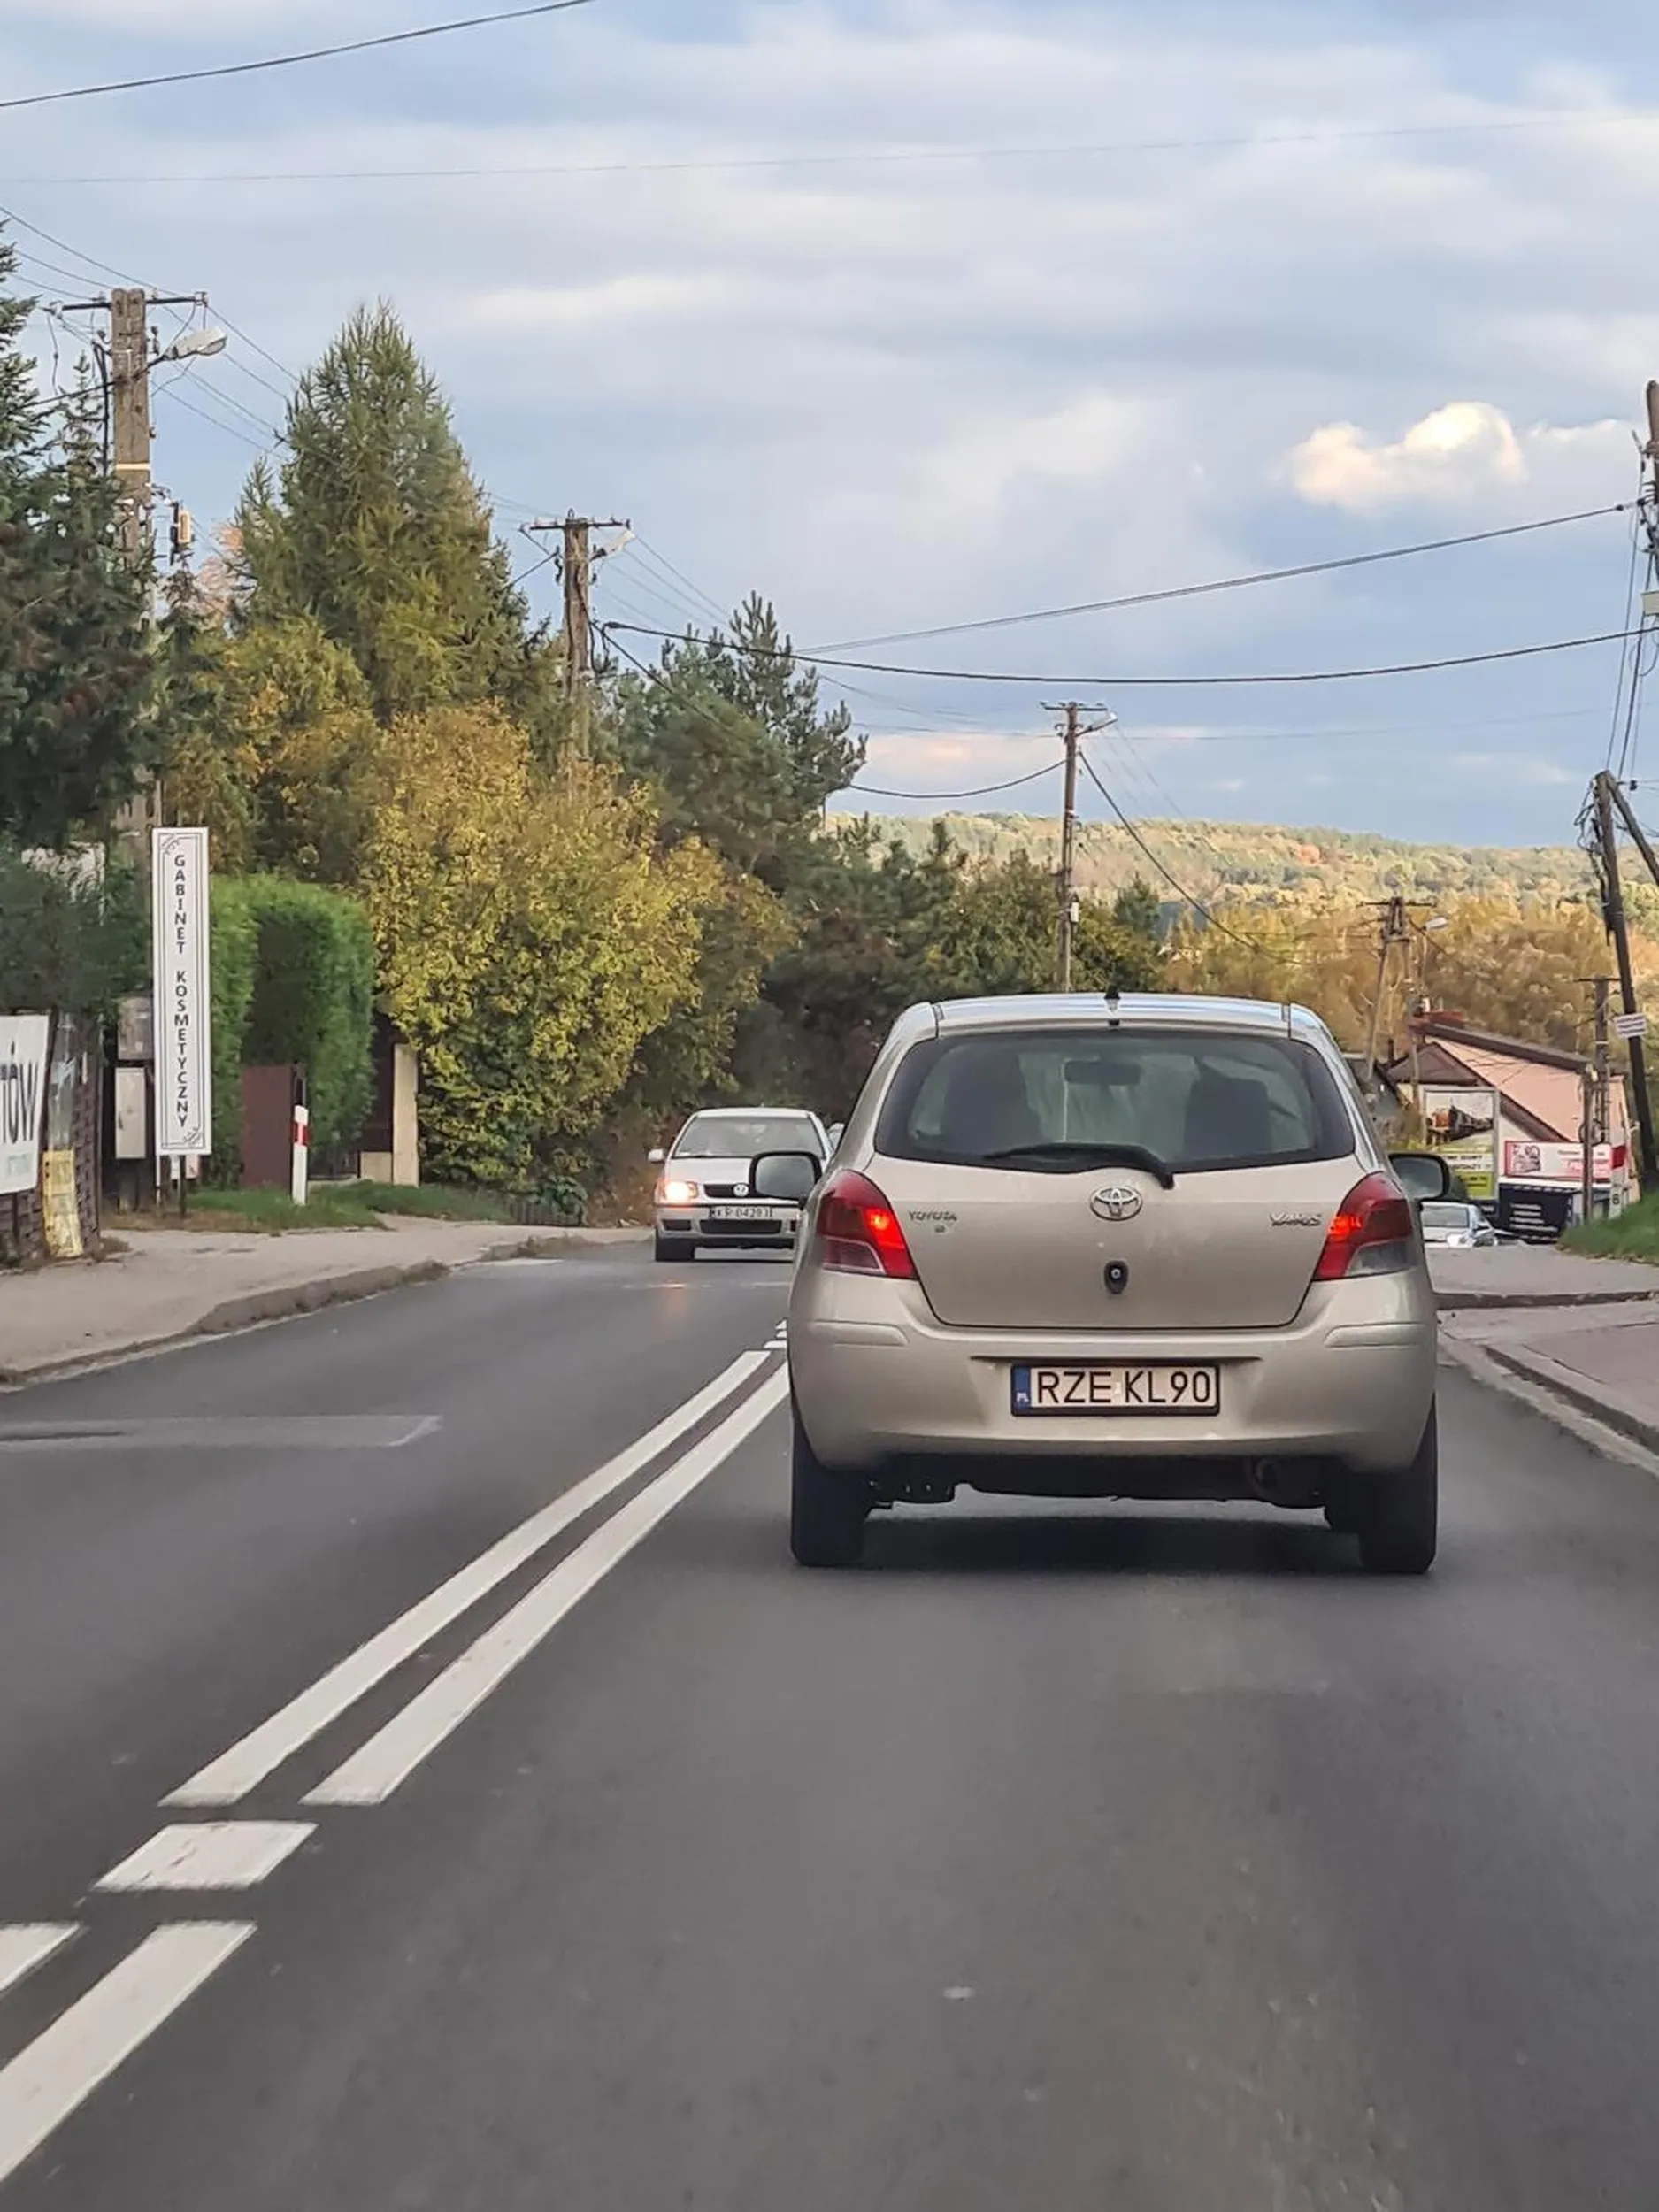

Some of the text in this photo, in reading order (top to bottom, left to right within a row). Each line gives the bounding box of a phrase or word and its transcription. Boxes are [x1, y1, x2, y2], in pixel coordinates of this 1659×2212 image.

[173, 855, 189, 1128] GABINET KOSMETYCZNY
[1037, 1371, 1210, 1403] RZE KL90
